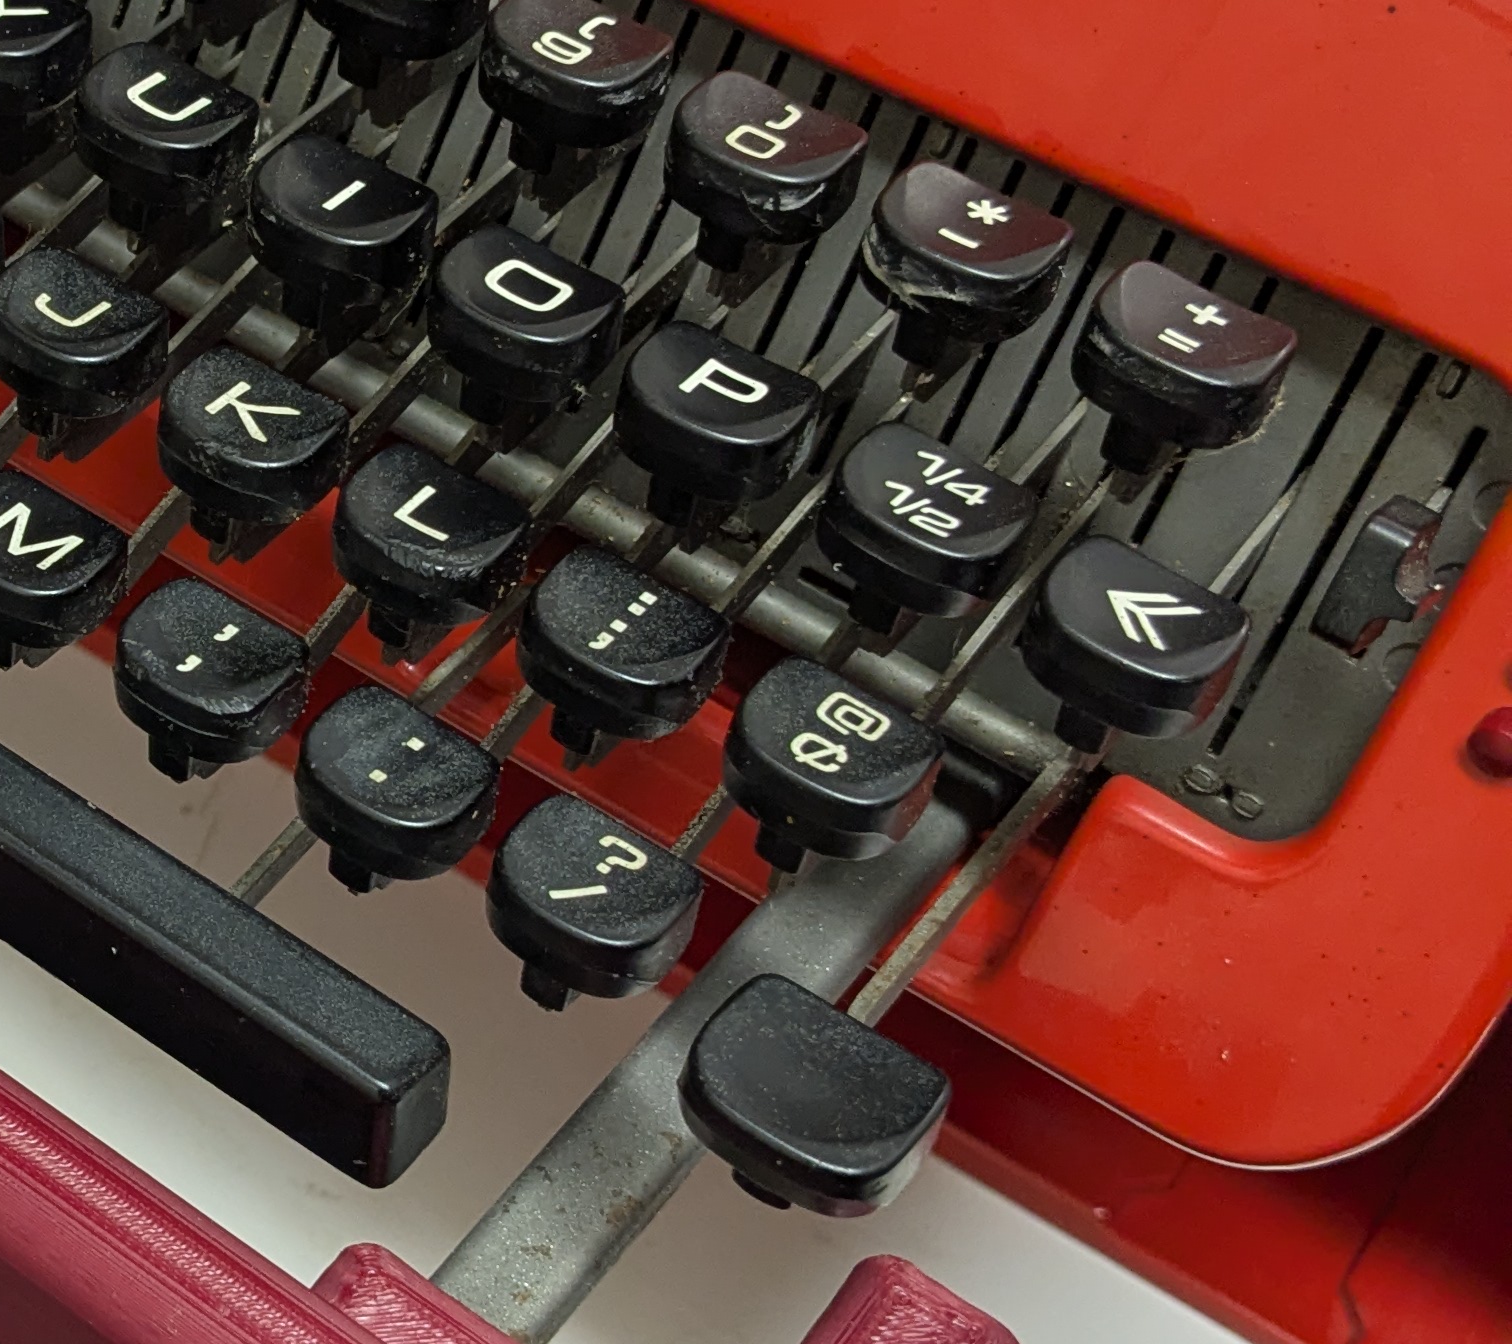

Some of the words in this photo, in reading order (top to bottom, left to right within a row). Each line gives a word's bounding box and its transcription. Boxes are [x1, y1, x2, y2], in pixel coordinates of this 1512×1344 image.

[530, 30, 594, 66] 9
[125, 70, 214, 123] U
[724, 123, 788, 160] 0
[320, 179, 367, 212] I
[483, 257, 575, 313] O
[33, 291, 113, 329] J
[1184, 302, 1229, 328] +
[1156, 326, 1203, 355] =
[677, 356, 770, 405] P
[203, 380, 302, 444] K
[392, 484, 451, 543] L
[815, 690, 893, 743] @
[594, 834, 649, 876] ?
